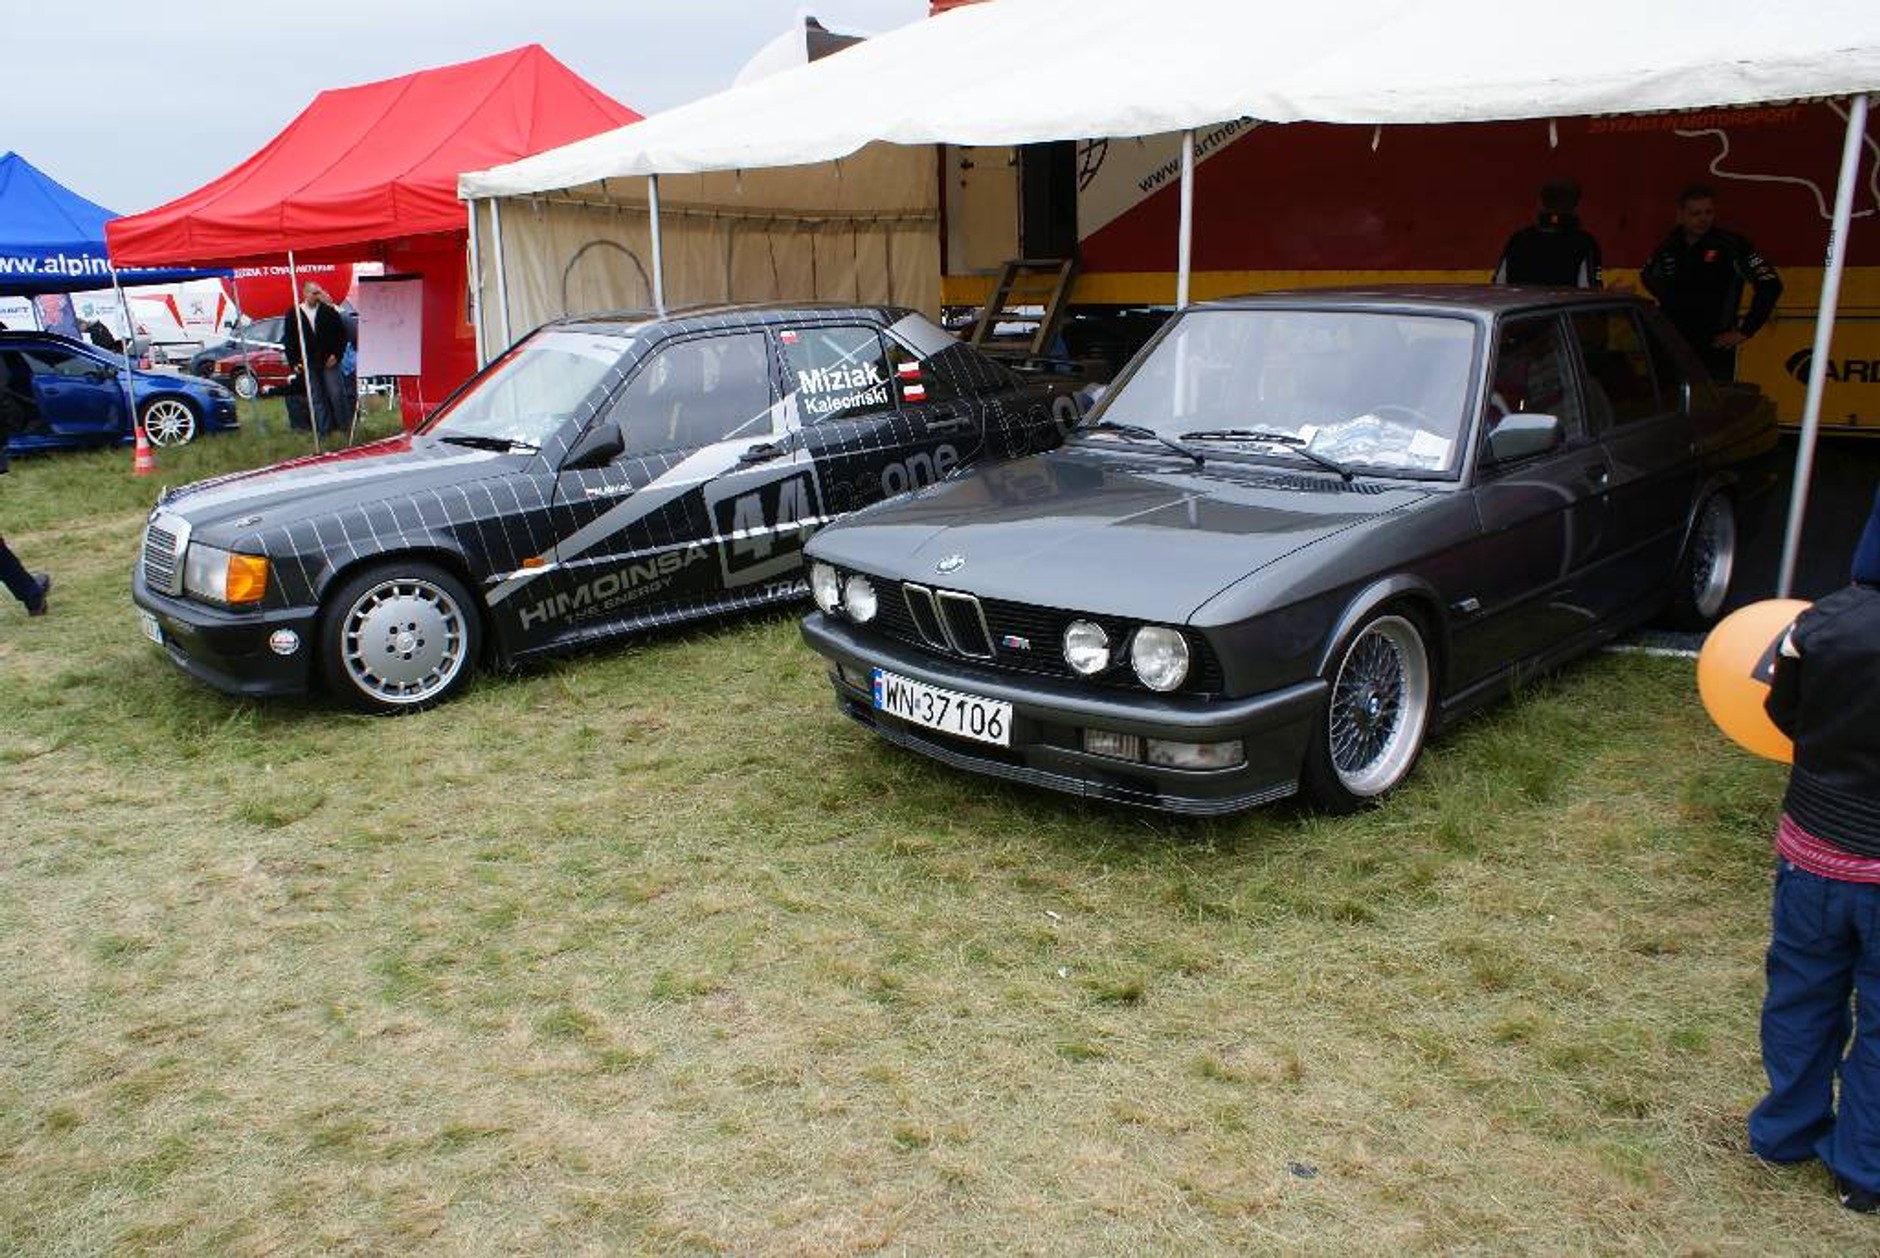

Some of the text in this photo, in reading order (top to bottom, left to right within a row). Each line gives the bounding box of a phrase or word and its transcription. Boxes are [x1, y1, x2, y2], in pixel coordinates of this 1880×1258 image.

[1138, 118, 1252, 193] www.artners
[798, 363, 883, 395] Miziak
[731, 475, 813, 561] 44
[518, 546, 708, 632] HIMOINSA
[604, 575, 673, 612] ENERGY
[764, 577, 810, 599] TRA
[886, 678, 1003, 740] WN 37106
